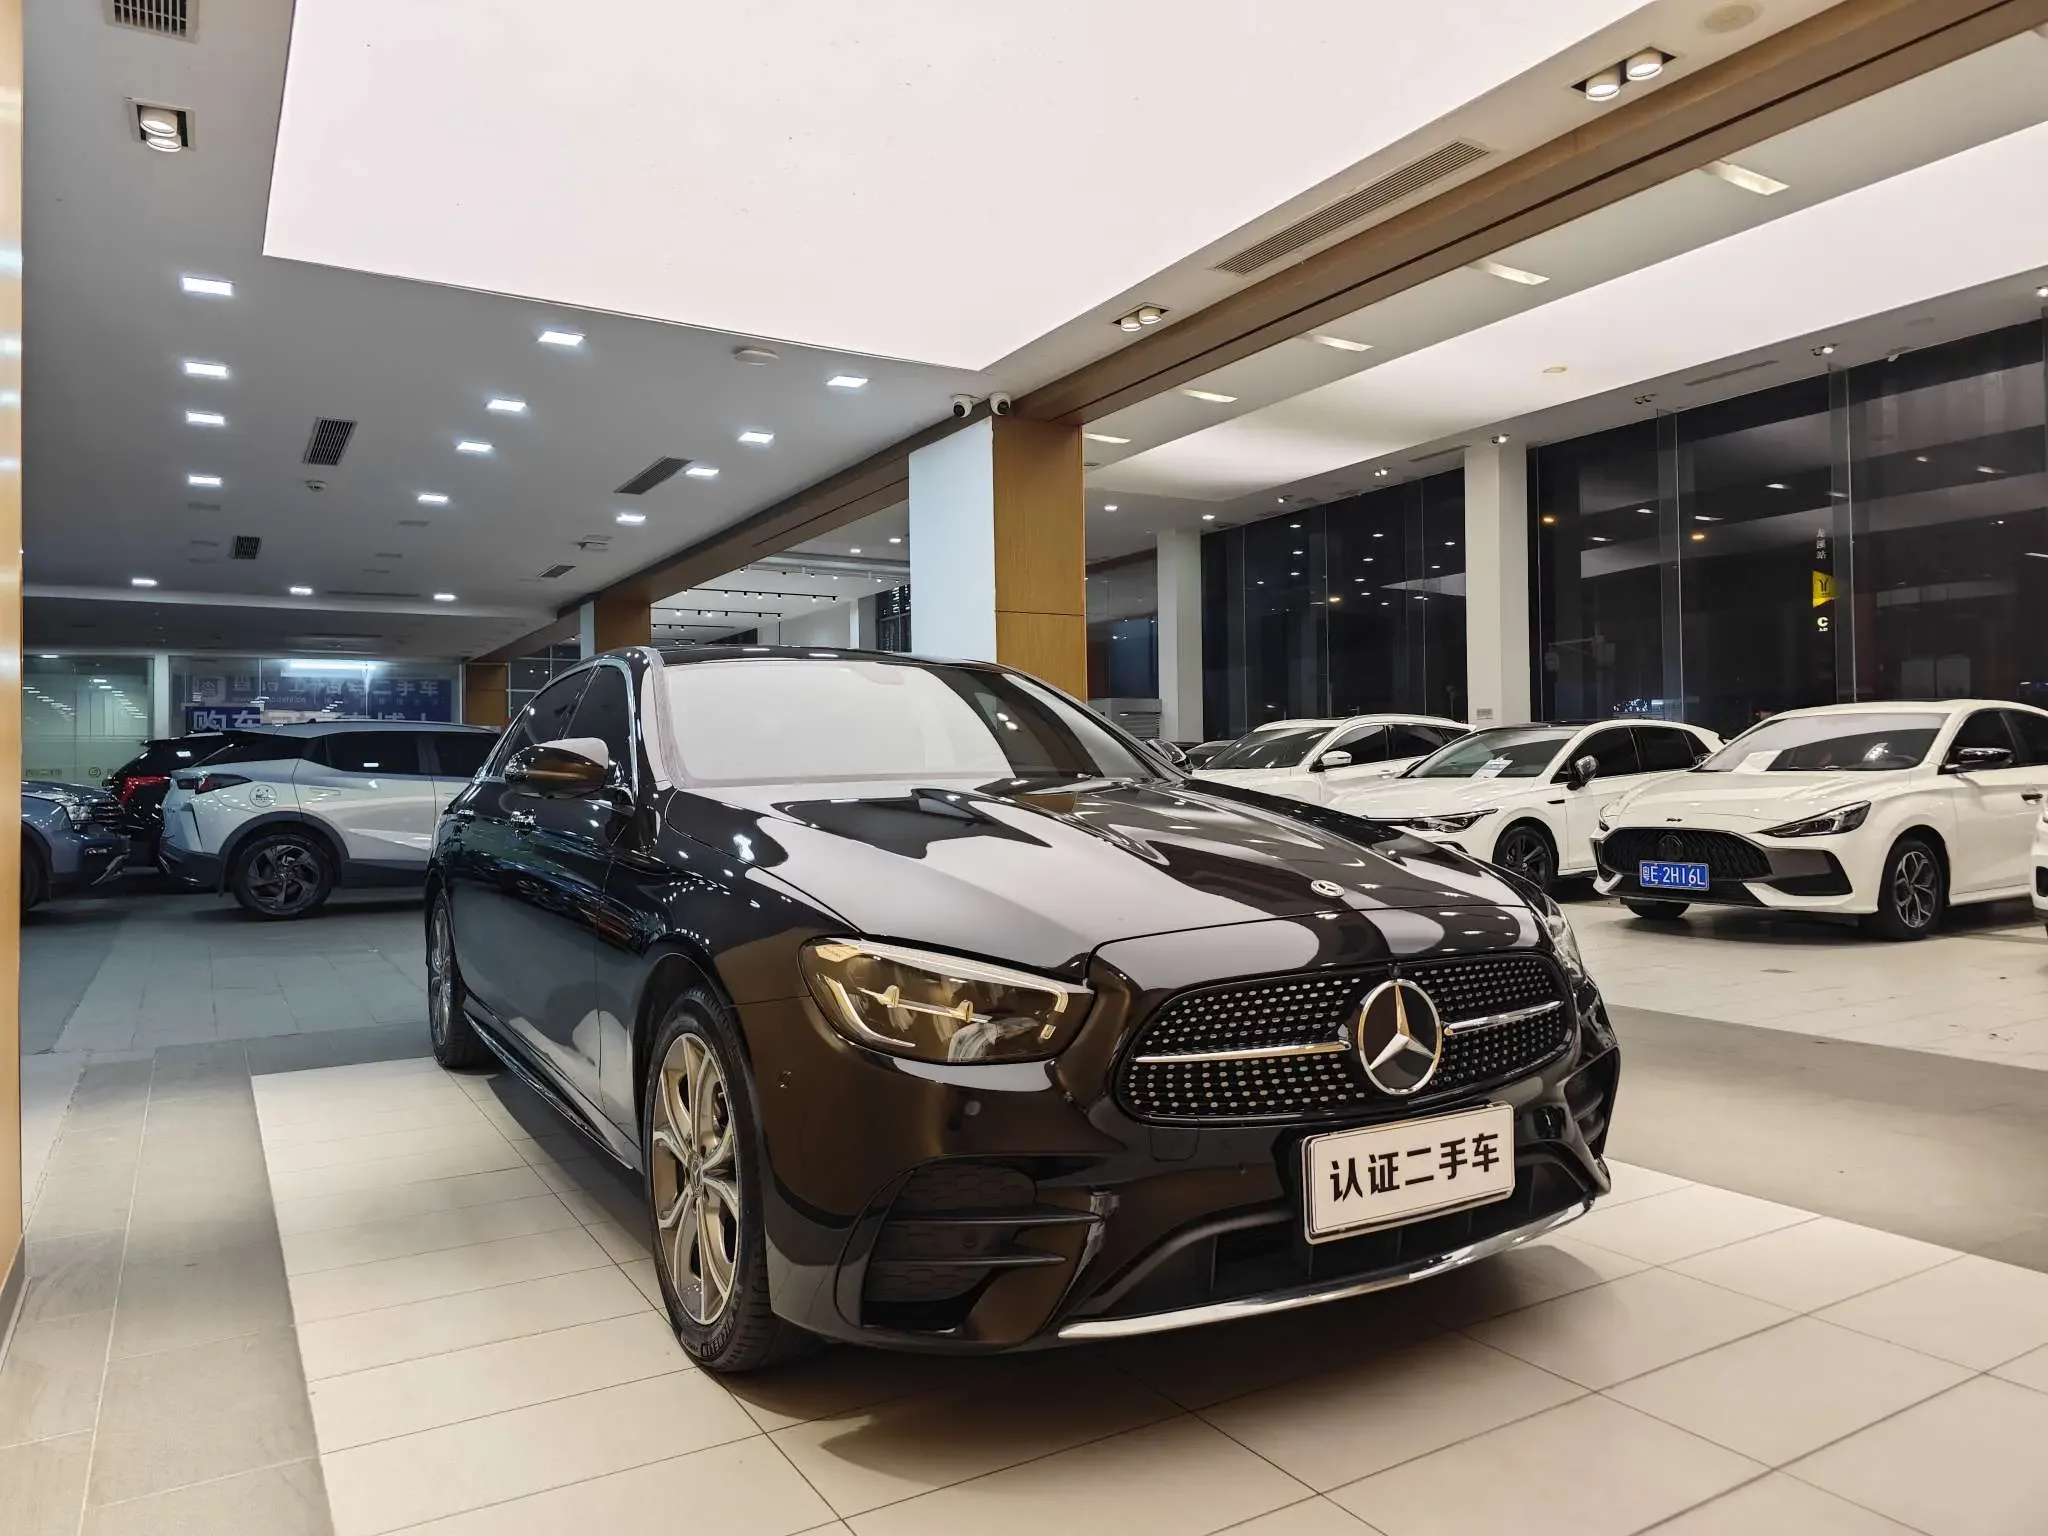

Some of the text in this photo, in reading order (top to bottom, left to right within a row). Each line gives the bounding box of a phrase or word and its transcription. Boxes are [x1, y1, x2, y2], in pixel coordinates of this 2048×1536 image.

[1329, 1132, 1500, 1202] 认证二手车
